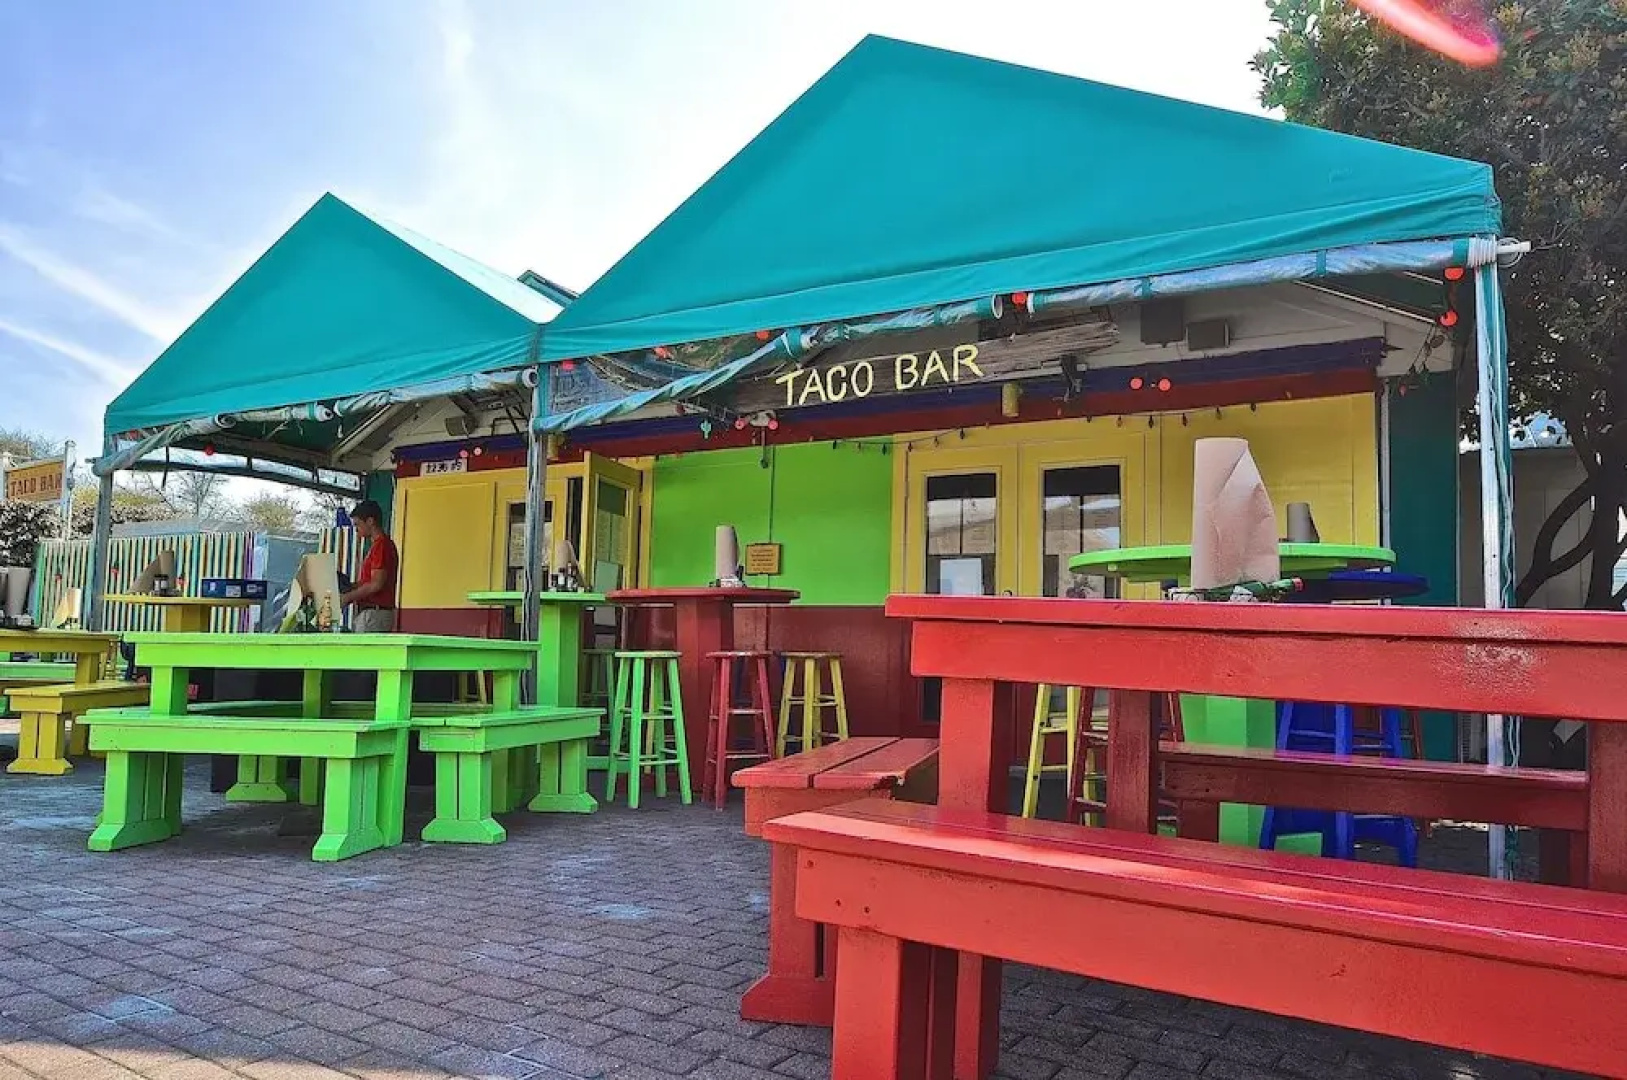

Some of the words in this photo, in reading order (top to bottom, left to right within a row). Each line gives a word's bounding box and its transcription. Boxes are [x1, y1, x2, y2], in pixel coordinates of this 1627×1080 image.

[776, 361, 873, 406] TACO
[894, 344, 984, 391] BAR
[11, 477, 37, 497] TACO
